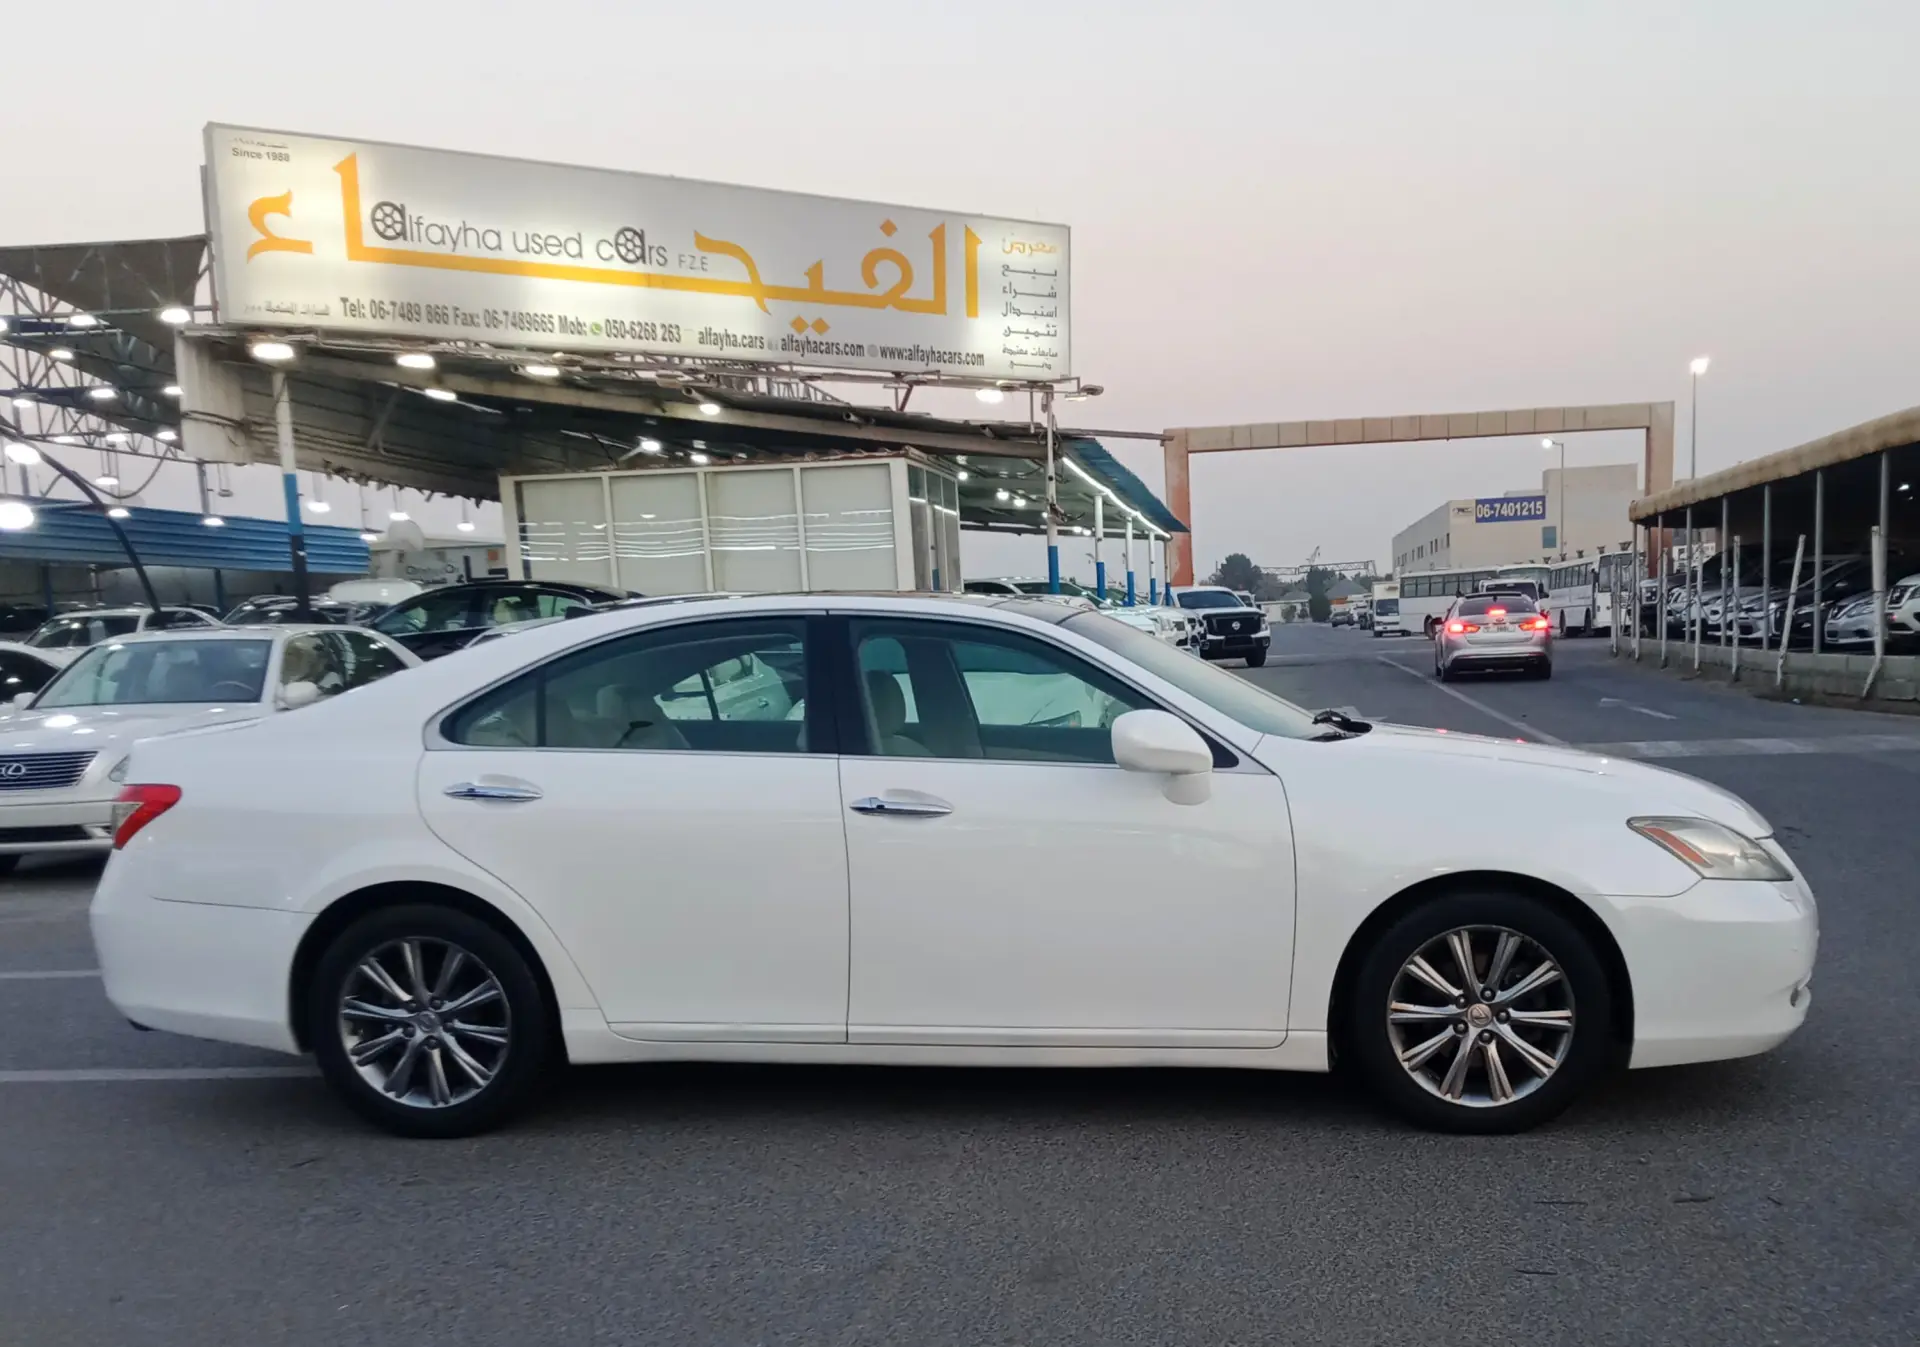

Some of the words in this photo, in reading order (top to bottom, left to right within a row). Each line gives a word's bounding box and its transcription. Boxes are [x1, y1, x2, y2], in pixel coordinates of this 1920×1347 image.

[232, 147, 262, 160] Since
[371, 201, 502, 252] alfayha
[512, 230, 583, 259] used
[596, 226, 669, 267] cars
[1002, 232, 1057, 256] معرض
[1002, 281, 1057, 298] شراء
[340, 296, 367, 319] Tel:
[370, 298, 421, 322] 06-7489
[453, 305, 480, 328] Fax:
[558, 314, 587, 336] Mob:
[605, 318, 658, 342] 050-6268
[661, 323, 682, 343] 263
[698, 326, 765, 351] alfayha.cars
[780, 334, 865, 357] alfayhacars.com
[1476, 501, 1543, 518] 06-7401215
